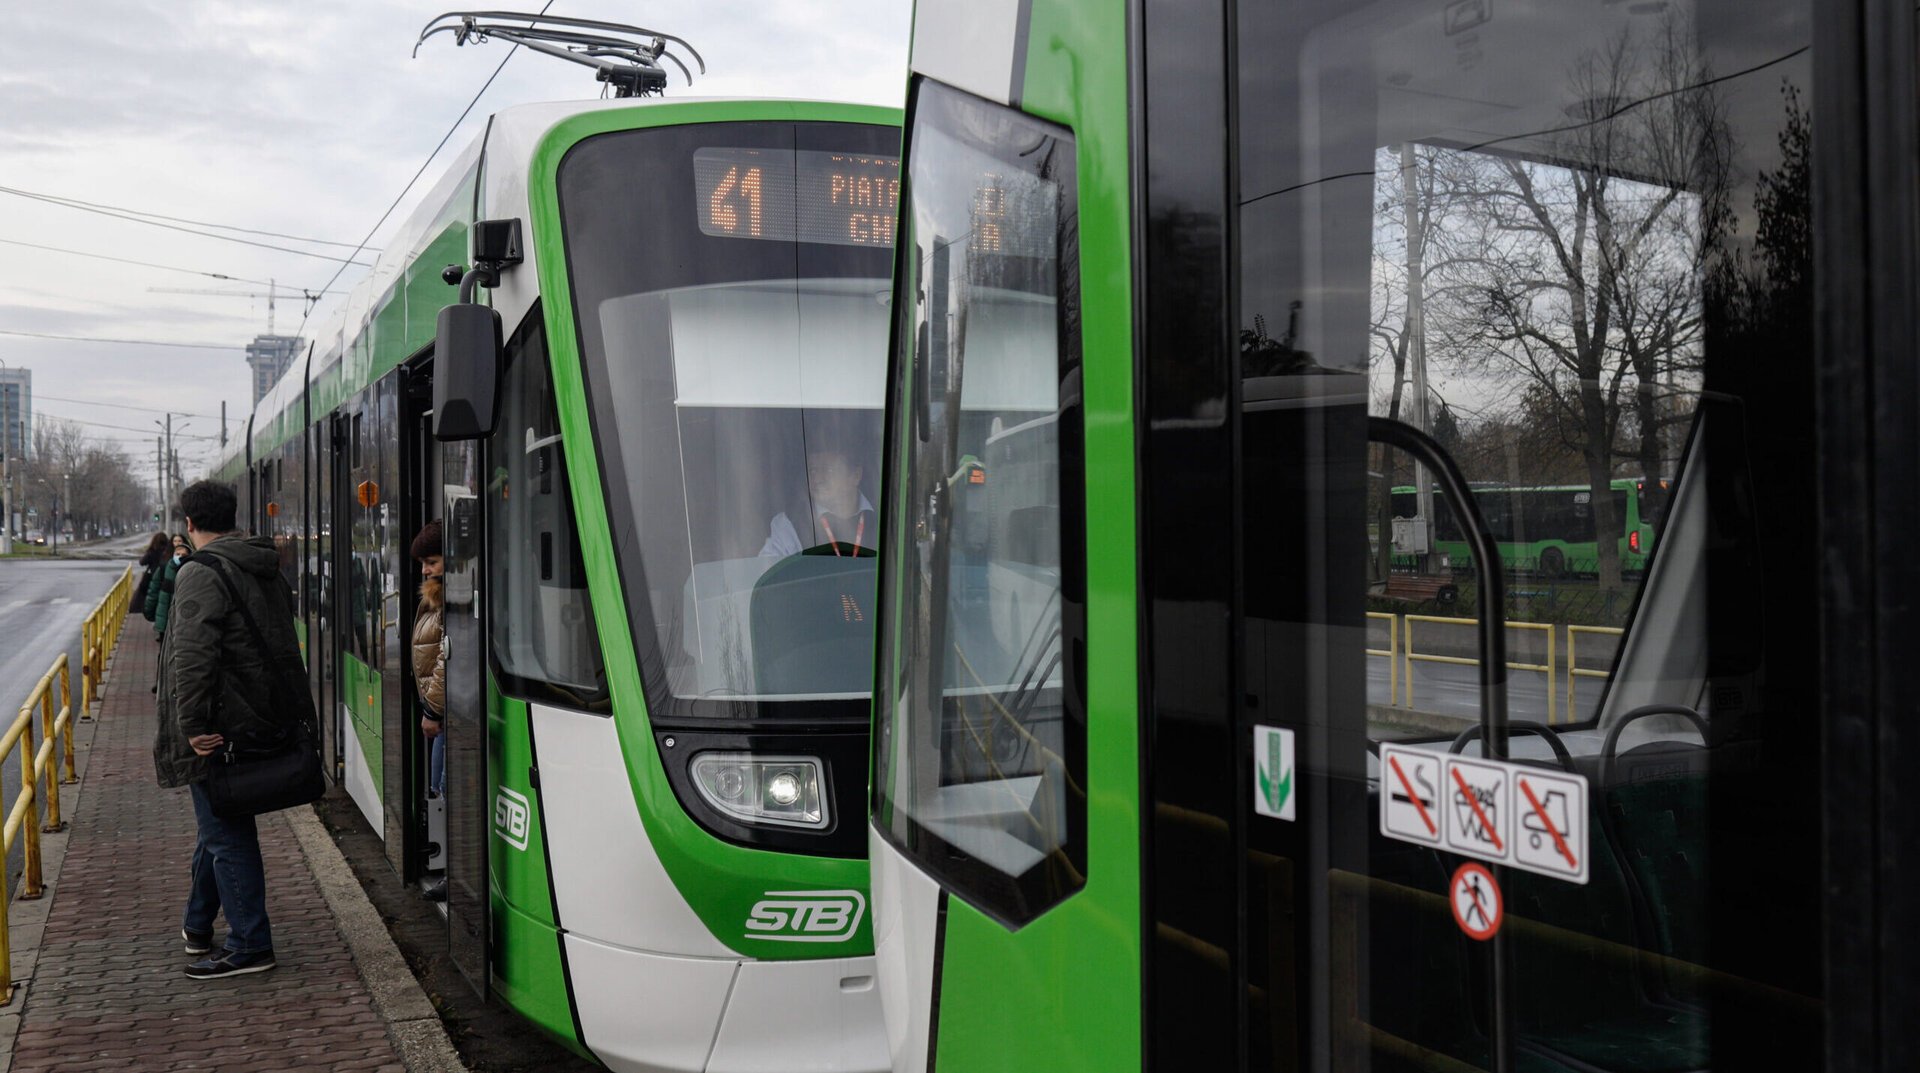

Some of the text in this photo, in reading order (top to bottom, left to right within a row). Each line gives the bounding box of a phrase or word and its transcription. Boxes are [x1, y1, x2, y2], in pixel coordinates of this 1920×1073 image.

[711, 166, 760, 237] 41
[495, 793, 526, 839] STB
[745, 899, 854, 932] STB
